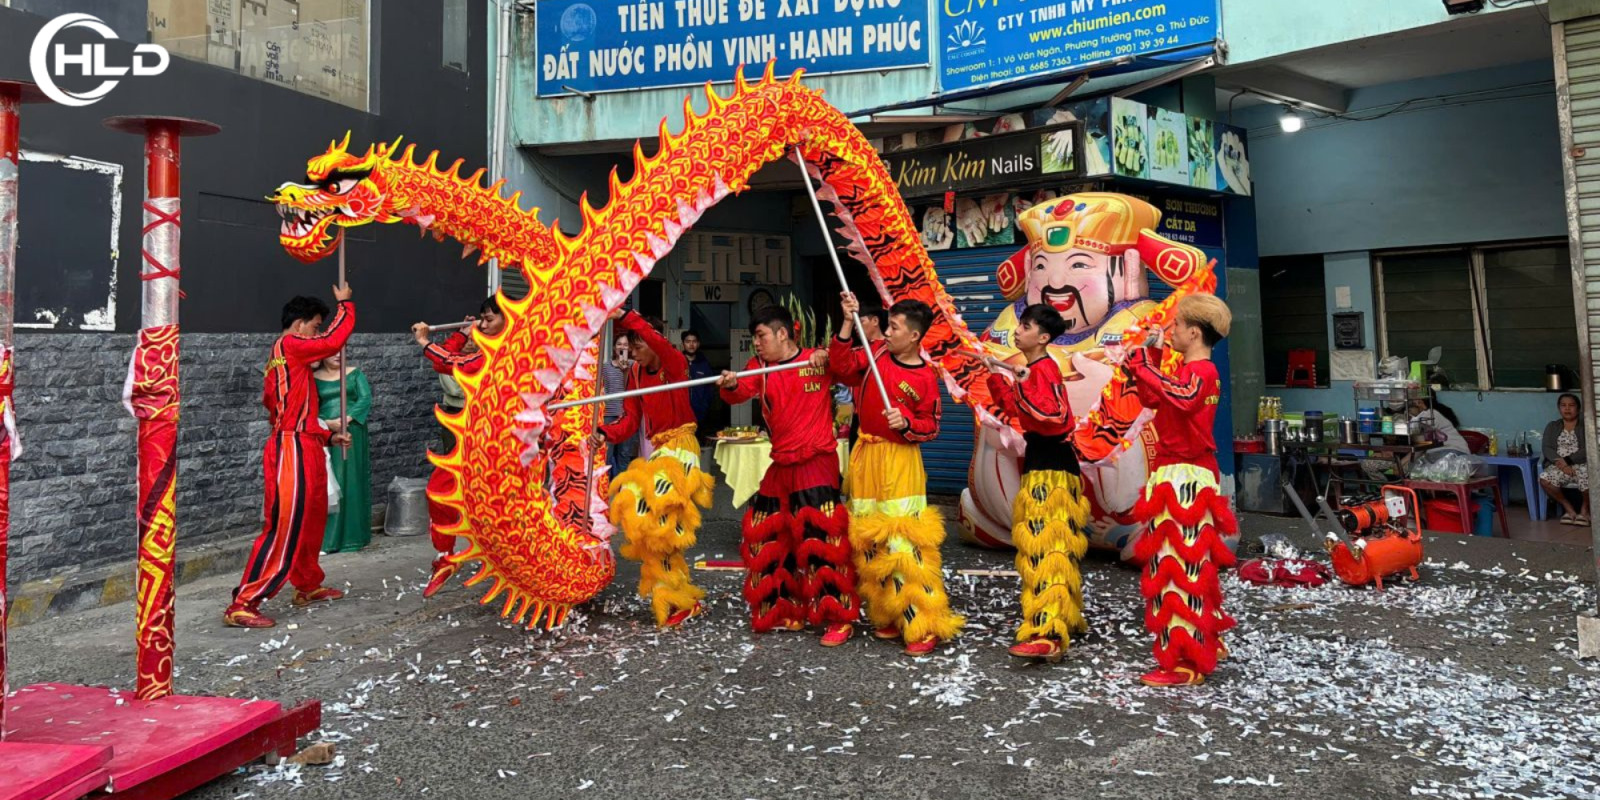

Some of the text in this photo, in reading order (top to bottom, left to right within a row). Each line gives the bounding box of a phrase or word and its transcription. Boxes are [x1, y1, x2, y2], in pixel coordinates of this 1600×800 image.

[998, 12, 1024, 31] CTY
[1030, 3, 1066, 24] TNHH
[1029, 4, 1166, 43] www.chiumien.com
[543, 44, 580, 82] ĐẤT
[589, 40, 644, 78] NƯỚC
[654, 33, 713, 72] PHỒN
[863, 16, 920, 54] PHÚC
[946, 62, 986, 76] Showroom
[988, 58, 996, 66] 1:
[1019, 51, 1035, 61] Văn
[1065, 40, 1098, 51] Phường
[1100, 32, 1132, 44] Trường
[1156, 24, 1167, 33] Q.
[1169, 18, 1186, 30] Thủ
[1189, 16, 1210, 27] Đức
[1030, 61, 1050, 72] 6685
[1052, 56, 1072, 67] 7363
[1080, 49, 1112, 62] Hotline:
[1116, 44, 1137, 54] 0901
[1140, 40, 1151, 50] 39
[1154, 38, 1164, 46] 39
[1166, 35, 1179, 44] 44
[898, 152, 1034, 188] Kim Kim Nails
[1184, 220, 1196, 232] DA
[704, 286, 722, 300] WC
